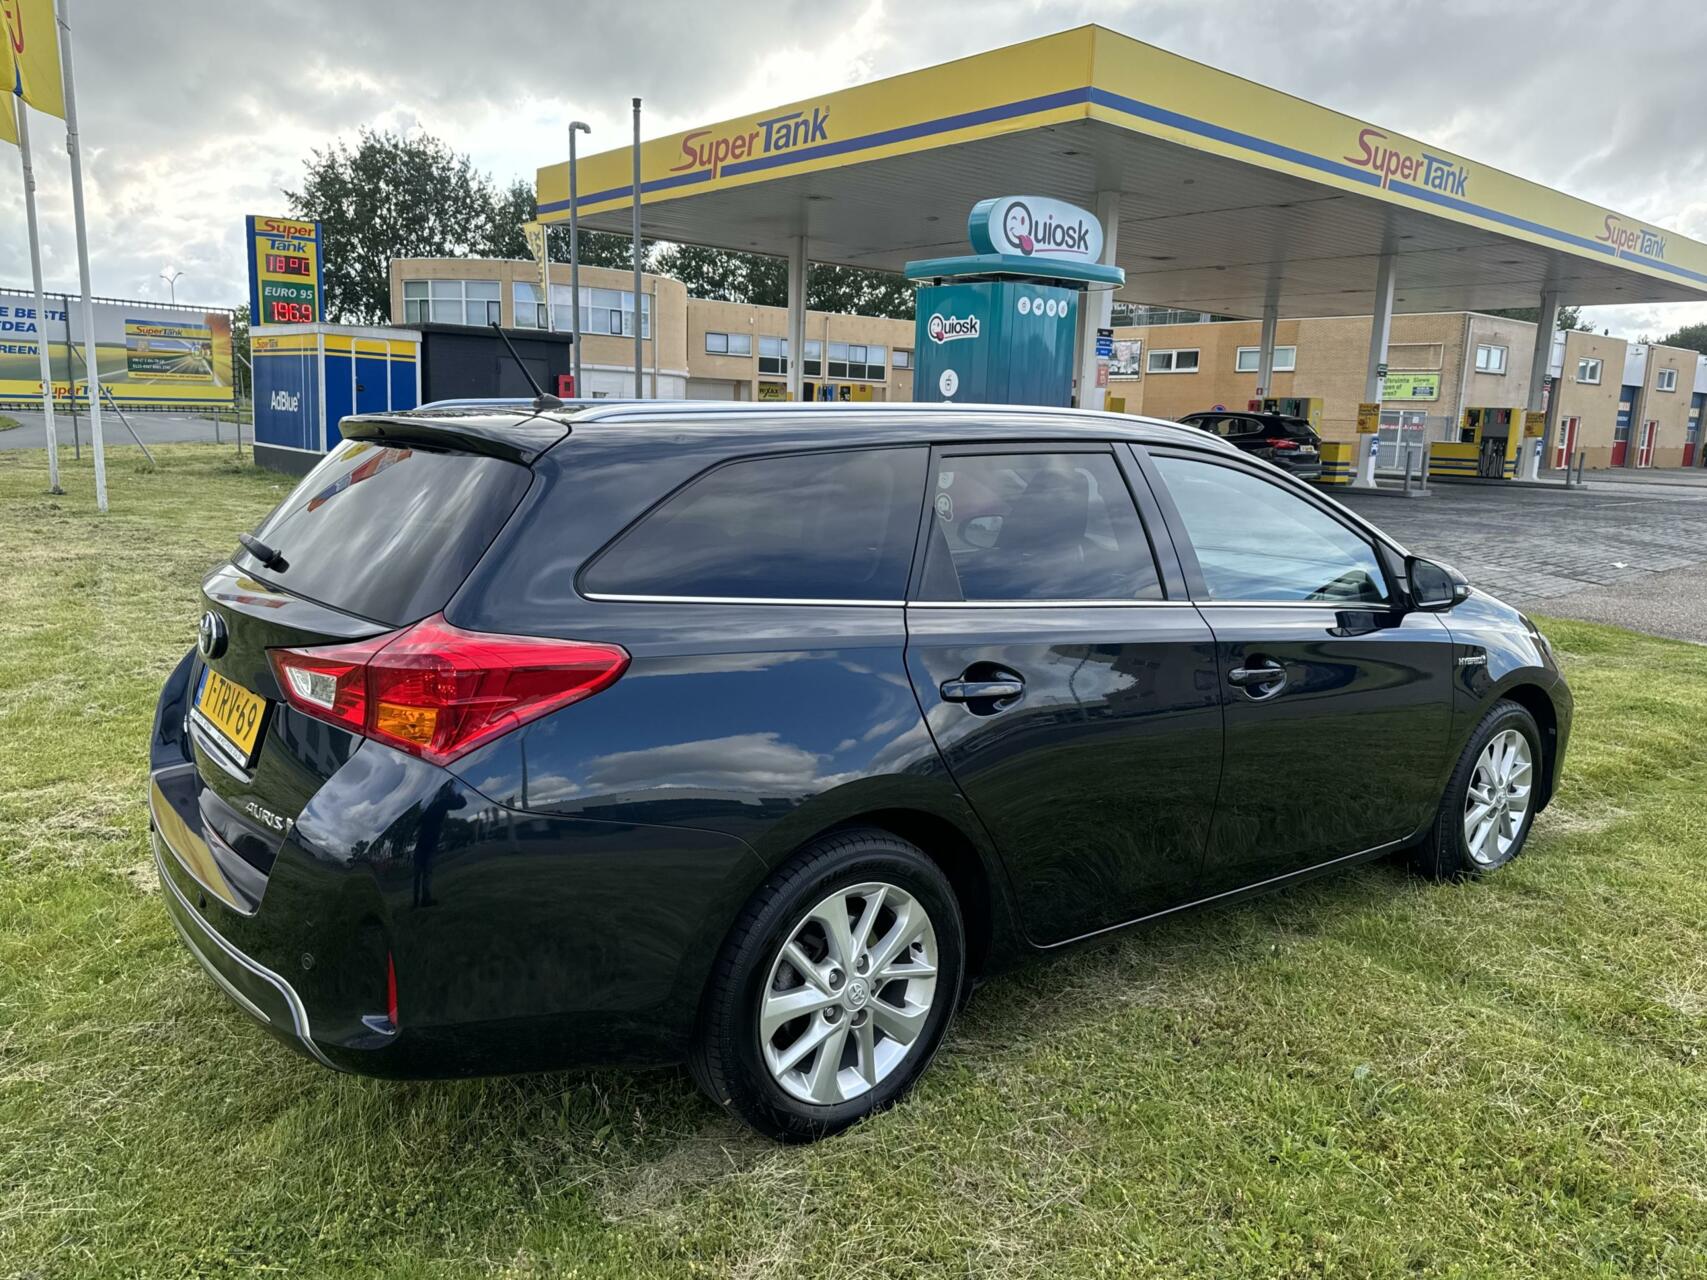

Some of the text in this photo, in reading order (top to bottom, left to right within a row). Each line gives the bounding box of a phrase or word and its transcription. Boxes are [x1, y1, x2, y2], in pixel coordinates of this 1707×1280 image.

[670, 107, 829, 179] SuperTank
[1344, 128, 1469, 197] SuperTank
[264, 219, 316, 239] Super
[1003, 201, 1089, 255] Quiosk
[1596, 214, 1666, 260] SuperTank
[265, 238, 308, 253] Tank
[264, 286, 313, 300] EURO 95
[929, 315, 978, 341] Quiosk
[270, 390, 299, 412] AdBlue
[206, 673, 258, 742] 1-TRV-69
[246, 802, 284, 831] AURIS
